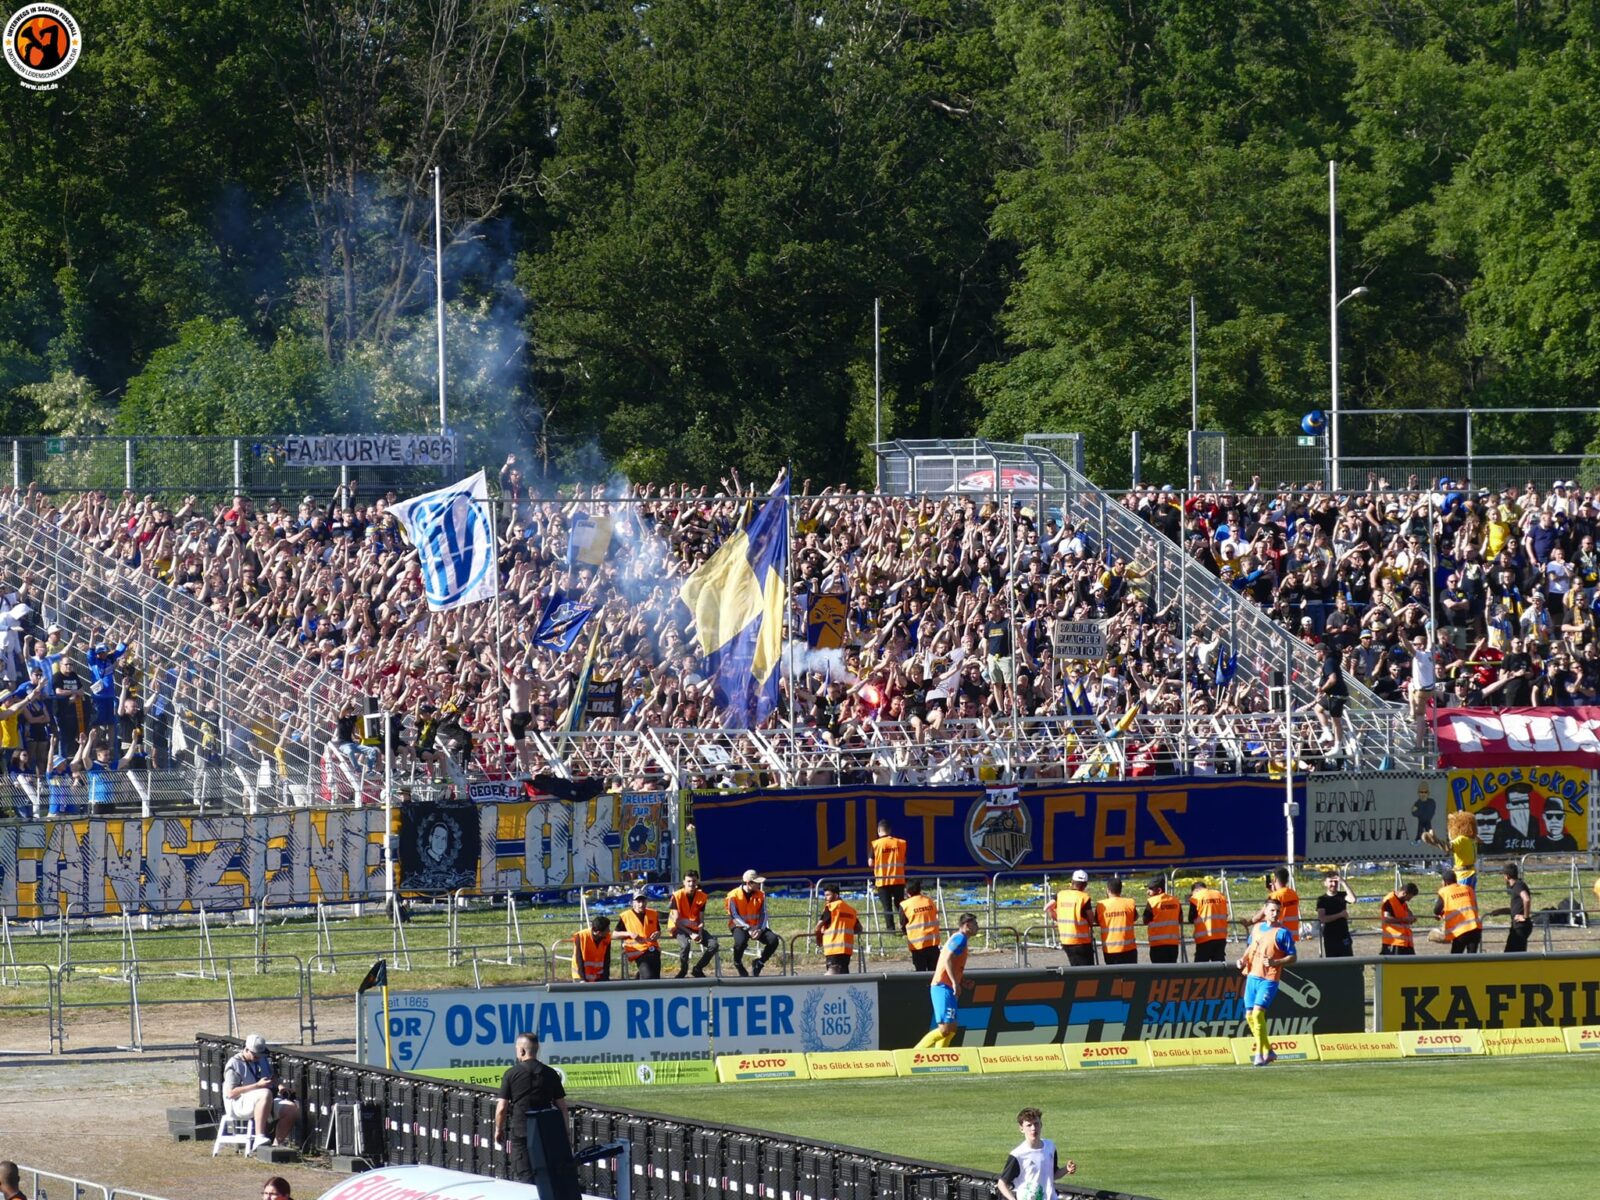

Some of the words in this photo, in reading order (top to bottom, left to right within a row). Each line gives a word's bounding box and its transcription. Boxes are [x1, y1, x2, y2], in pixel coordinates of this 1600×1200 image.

[287, 439, 400, 462] FANKURVE
[408, 439, 452, 461] 1966
[470, 784, 505, 797] GEGEN
[1315, 789, 1377, 814] BANDA
[1314, 816, 1410, 844] RESOLUTA
[1148, 975, 1246, 1003] HEIZUN
[403, 997, 429, 1008] 1865
[823, 996, 847, 1015] seit
[445, 1000, 610, 1047] OSWALD
[627, 995, 795, 1039] RICHTER
[821, 1016, 852, 1036] 1865
[1430, 1035, 1462, 1044] LOTTO
[1096, 1046, 1128, 1056] LOTTO
[1270, 1041, 1297, 1050] OTTO
[926, 1053, 960, 1062] LOTTO
[1169, 1048, 1190, 1057] Glück
[1192, 1048, 1203, 1056] ist
[1214, 1047, 1231, 1055] nah.
[752, 1058, 786, 1068] LOTTO
[983, 1056, 998, 1064] Das
[999, 1054, 1021, 1063] Glück
[1023, 1054, 1033, 1062] ist
[1046, 1053, 1062, 1061] nah.
[812, 1063, 828, 1071] Das
[830, 1061, 851, 1070] Glück
[853, 1061, 863, 1069] ist
[876, 1060, 894, 1068] nah.
